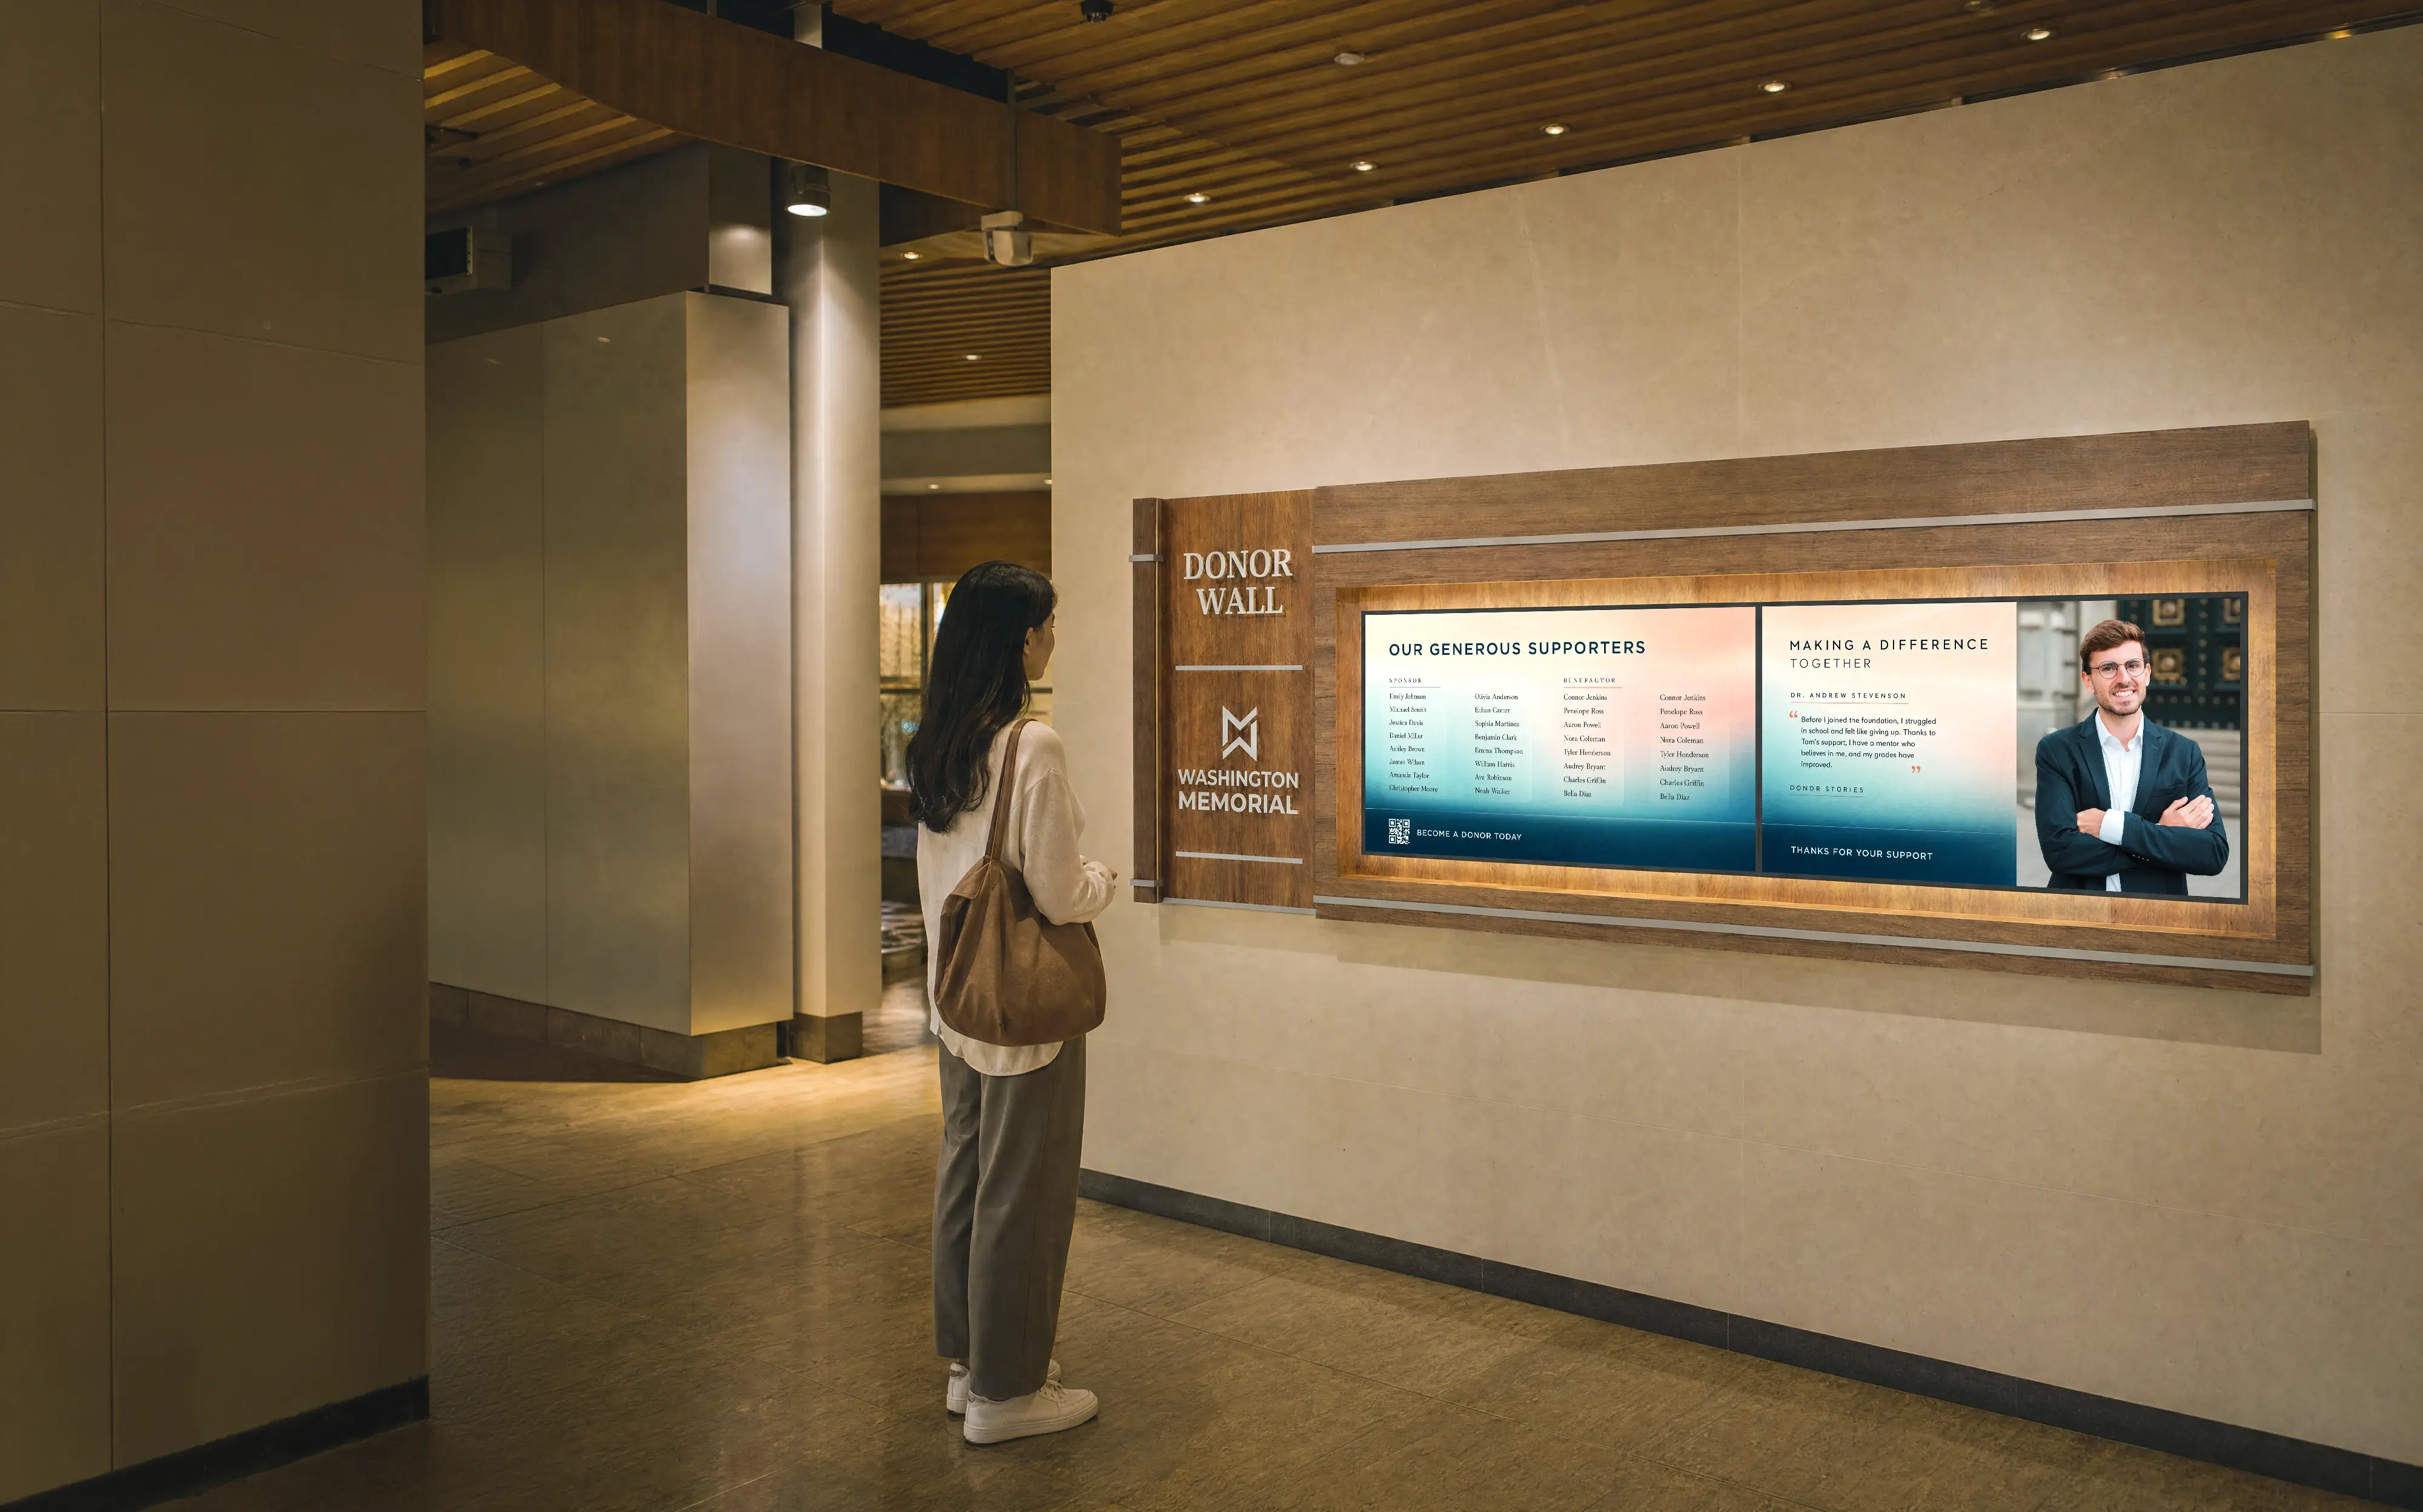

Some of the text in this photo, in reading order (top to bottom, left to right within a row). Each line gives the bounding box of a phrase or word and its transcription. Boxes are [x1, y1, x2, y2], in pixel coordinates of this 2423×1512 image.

[1183, 548, 1293, 580] DONOR
[1196, 586, 1284, 615] WALL
[1389, 640, 1645, 656] OUR GENEROUS SUPPORTERS
[1790, 638, 1988, 651] MAKING A DIFFERENCE
[1790, 658, 1871, 669] TOGETHER
[1563, 707, 1589, 716] Penelope
[1660, 708, 1687, 717] Penelope
[1861, 717, 1899, 725] foundation,
[1905, 718, 1937, 726] struggled
[1869, 728, 1889, 737] giving
[1494, 747, 1523, 756] Thompson
[1660, 751, 1675, 759] Tyler
[1874, 751, 1897, 760] grades
[1563, 763, 1606, 771] Audrey Bryant
[1660, 764, 1704, 774] Audrey Bryant
[1801, 761, 1832, 769] improved.
[1178, 769, 1299, 788] WASHINGTON
[1413, 772, 1430, 780] Taylor
[1389, 784, 1420, 793] Christopher
[1178, 792, 1299, 815] MEMORIAL
[1417, 829, 1450, 837] BECOME
[1494, 832, 1522, 841] TODAY
[1791, 846, 1933, 860] THANKS FOR YOUR SUPPORT
